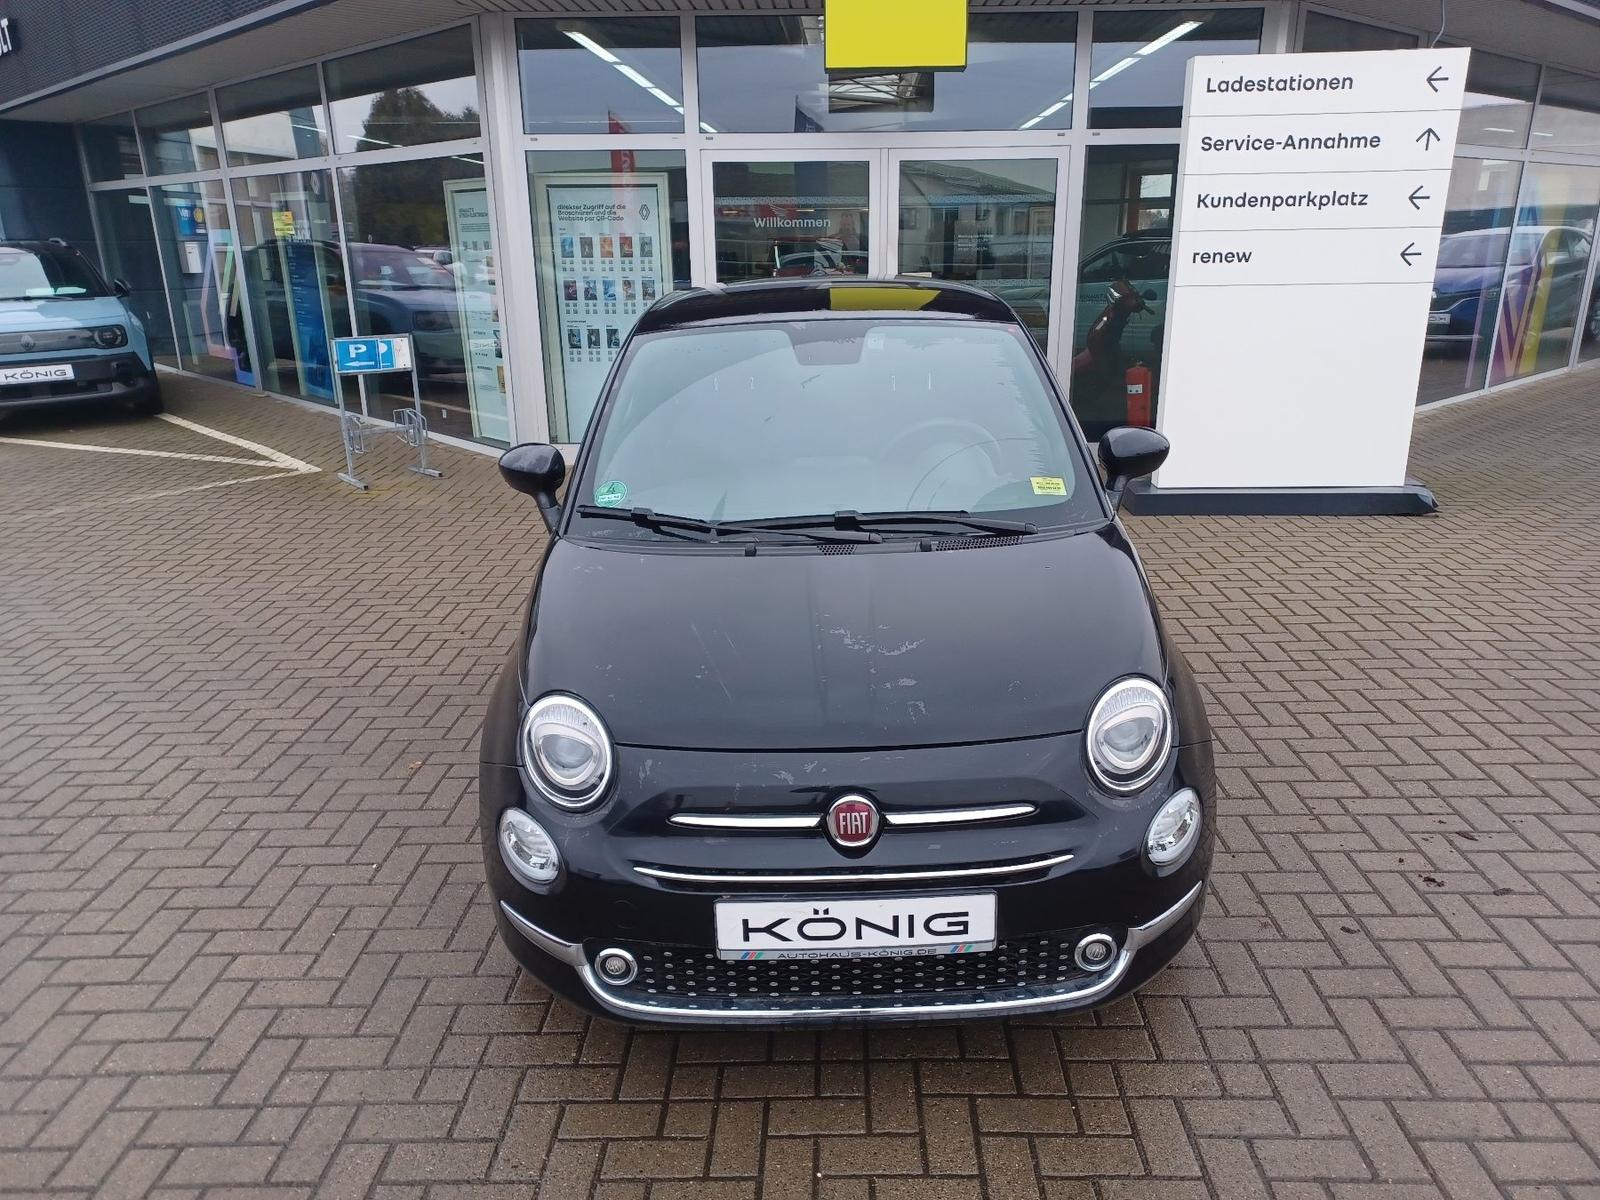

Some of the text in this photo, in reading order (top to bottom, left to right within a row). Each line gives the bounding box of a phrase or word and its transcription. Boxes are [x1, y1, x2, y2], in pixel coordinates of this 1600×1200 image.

[0, 18, 12, 56] LT
[1206, 74, 1354, 94] Ladestationen
[1200, 132, 1381, 152] Service-Annahme
[1197, 190, 1369, 211] Kundenparkplatz
[753, 217, 831, 228] Willkommen
[1192, 248, 1252, 265] renew
[349, 344, 367, 358] P
[4, 369, 67, 381] KÖNIG
[839, 811, 868, 835] FIAT
[741, 907, 969, 942] KÖNIG
[776, 947, 937, 960] AUTOHAUS-KÖNIG.DE
